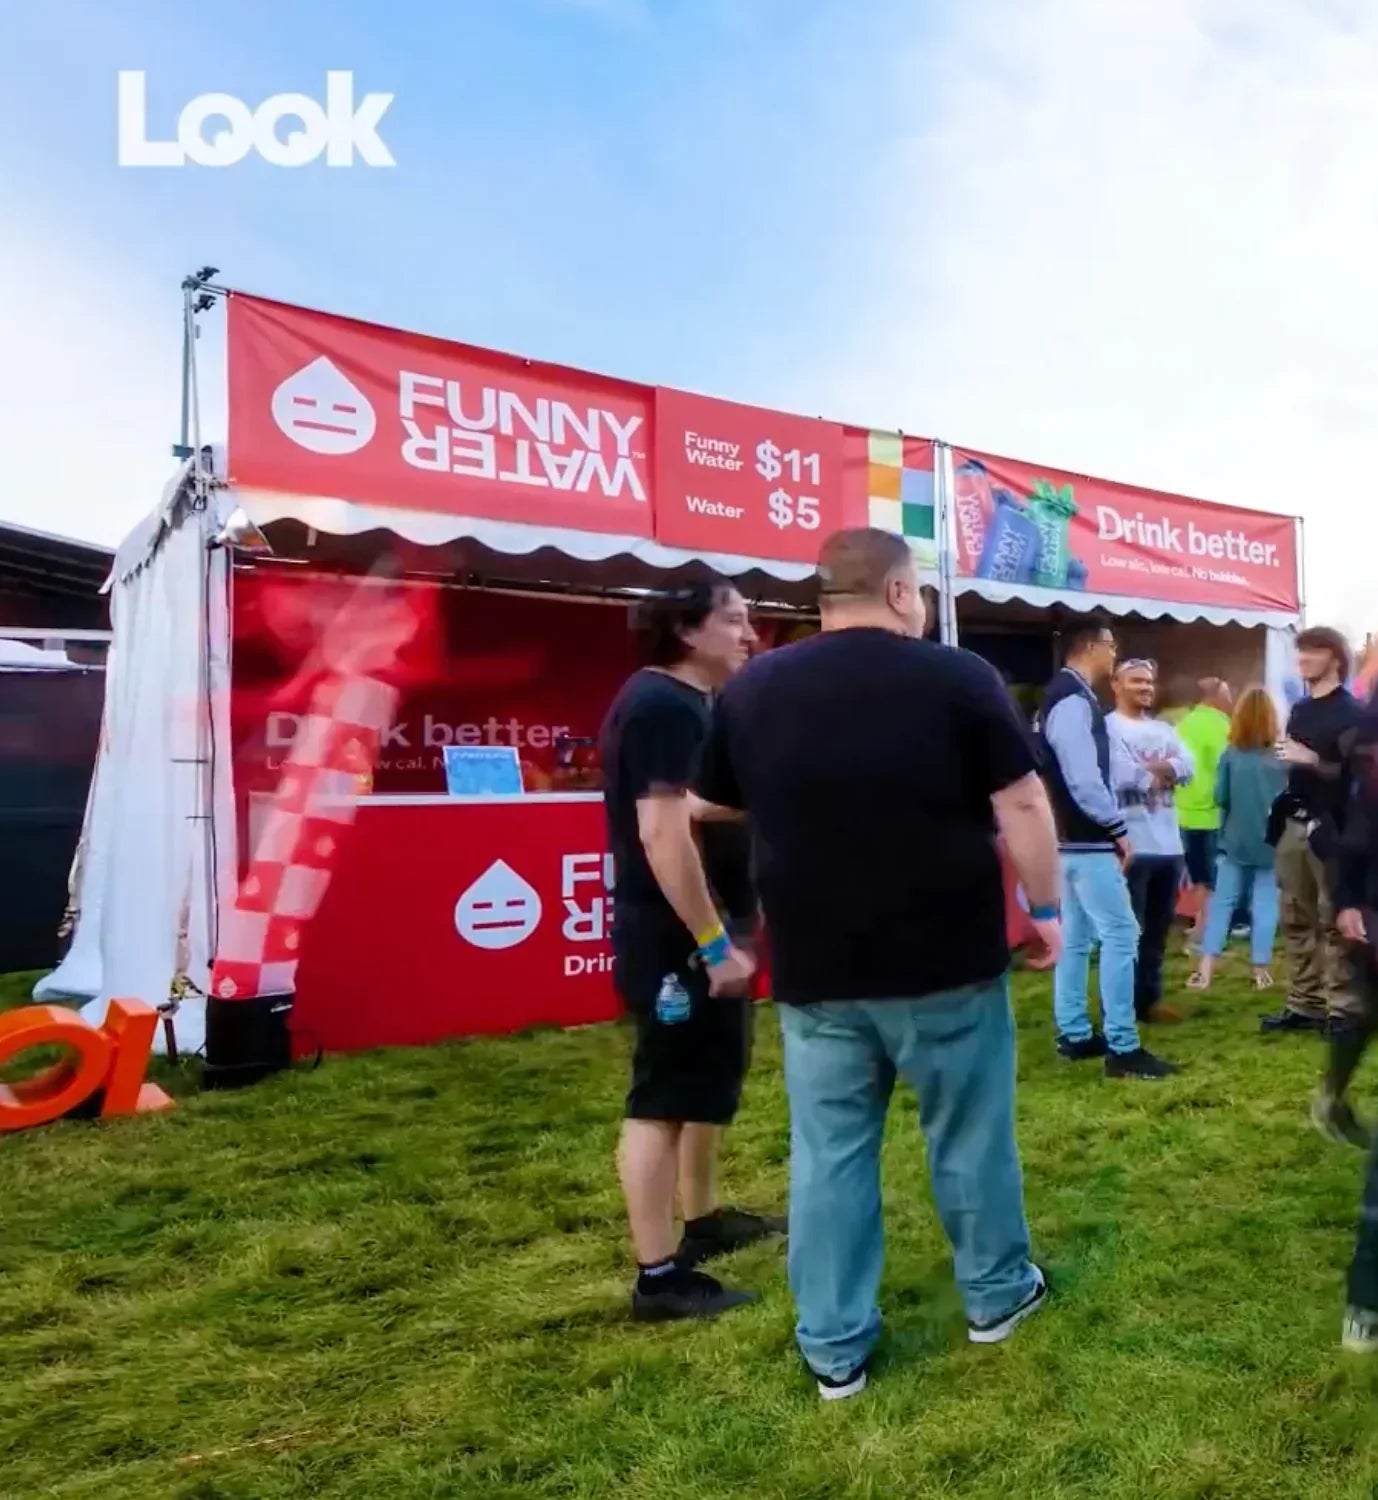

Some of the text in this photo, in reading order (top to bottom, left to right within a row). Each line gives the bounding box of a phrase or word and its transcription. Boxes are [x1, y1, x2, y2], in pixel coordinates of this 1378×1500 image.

[399, 370, 643, 456] FUNNY
[401, 418, 646, 502] WATER
[684, 430, 740, 458] Funny
[685, 448, 744, 471] Water
[755, 439, 820, 486] $11
[685, 487, 821, 530] Water $5
[1096, 505, 1184, 553] Drink
[1188, 521, 1280, 567] better.
[1192, 566, 1208, 581] No
